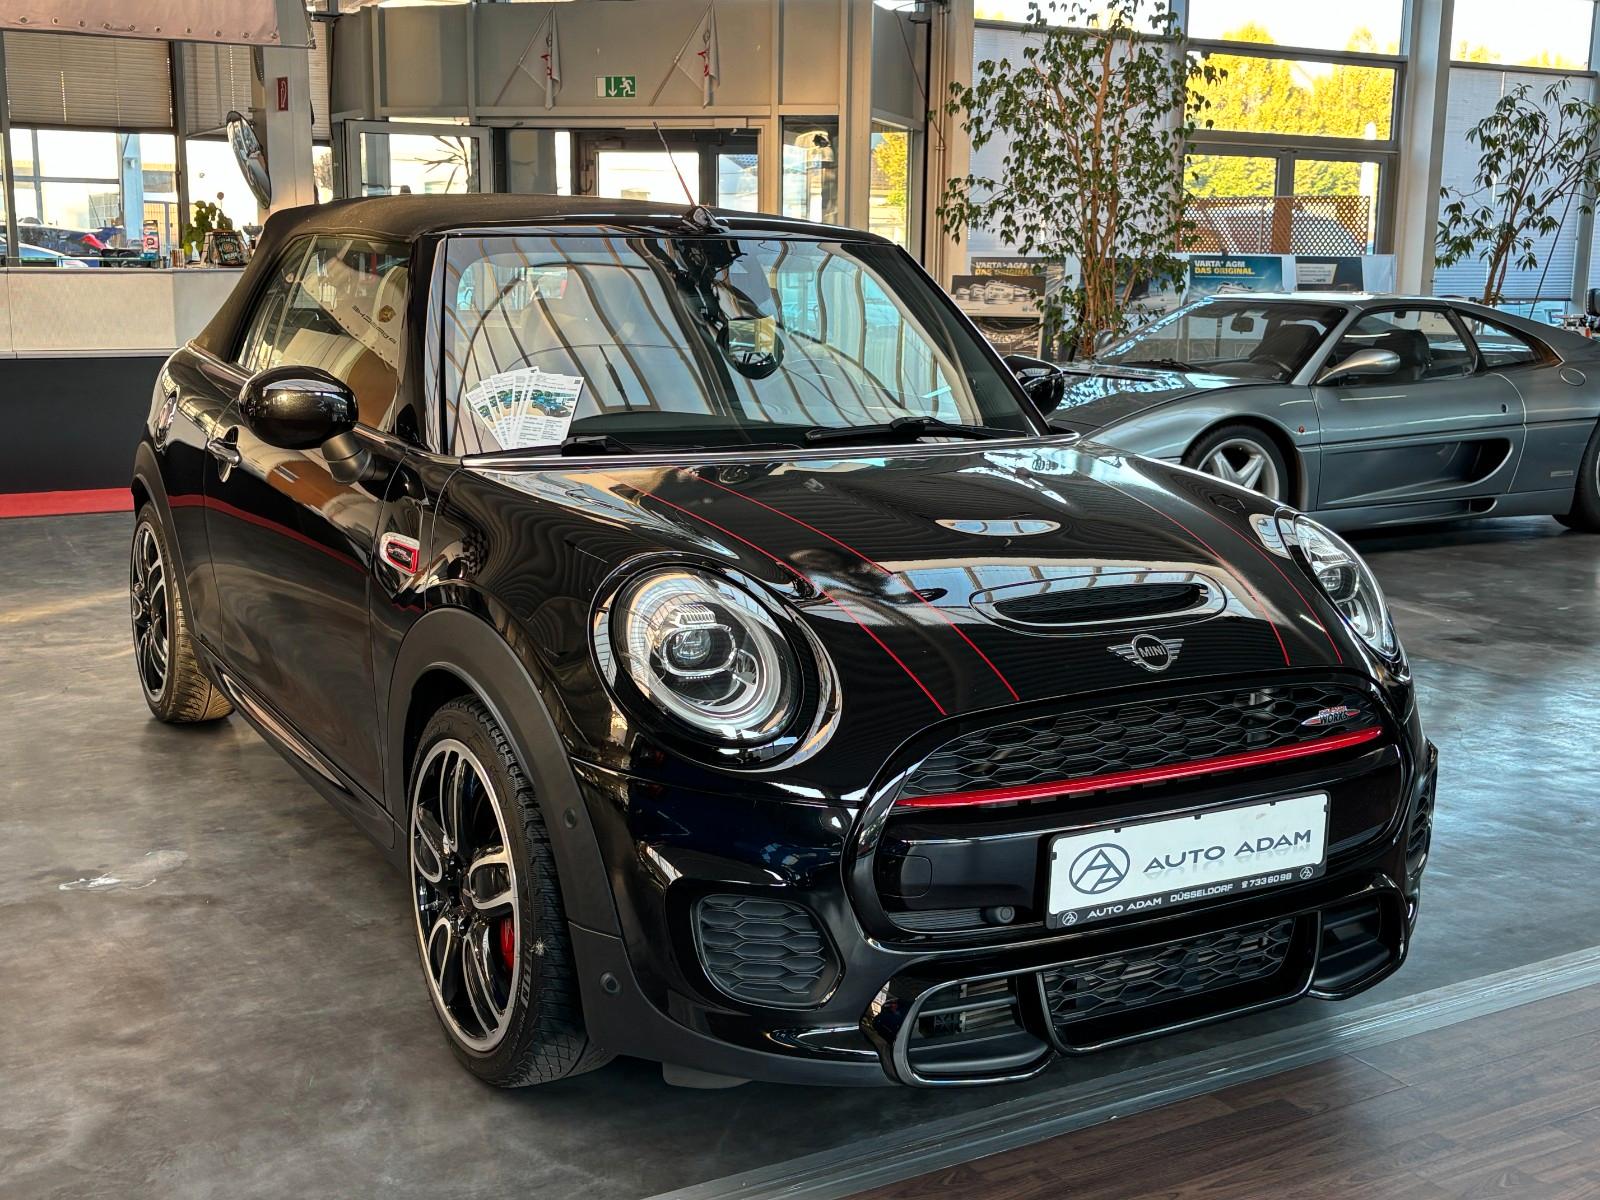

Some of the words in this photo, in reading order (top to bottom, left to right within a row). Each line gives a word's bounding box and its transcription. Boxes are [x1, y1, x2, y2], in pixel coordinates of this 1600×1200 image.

[1138, 645, 1167, 657] MINI
[1143, 845, 1226, 873] AUTO
[1234, 829, 1312, 857] ADAM
[1086, 905, 1124, 919] AUTO
[1126, 897, 1162, 911] ADAM
[1170, 884, 1233, 902] DÜSSELDORF
